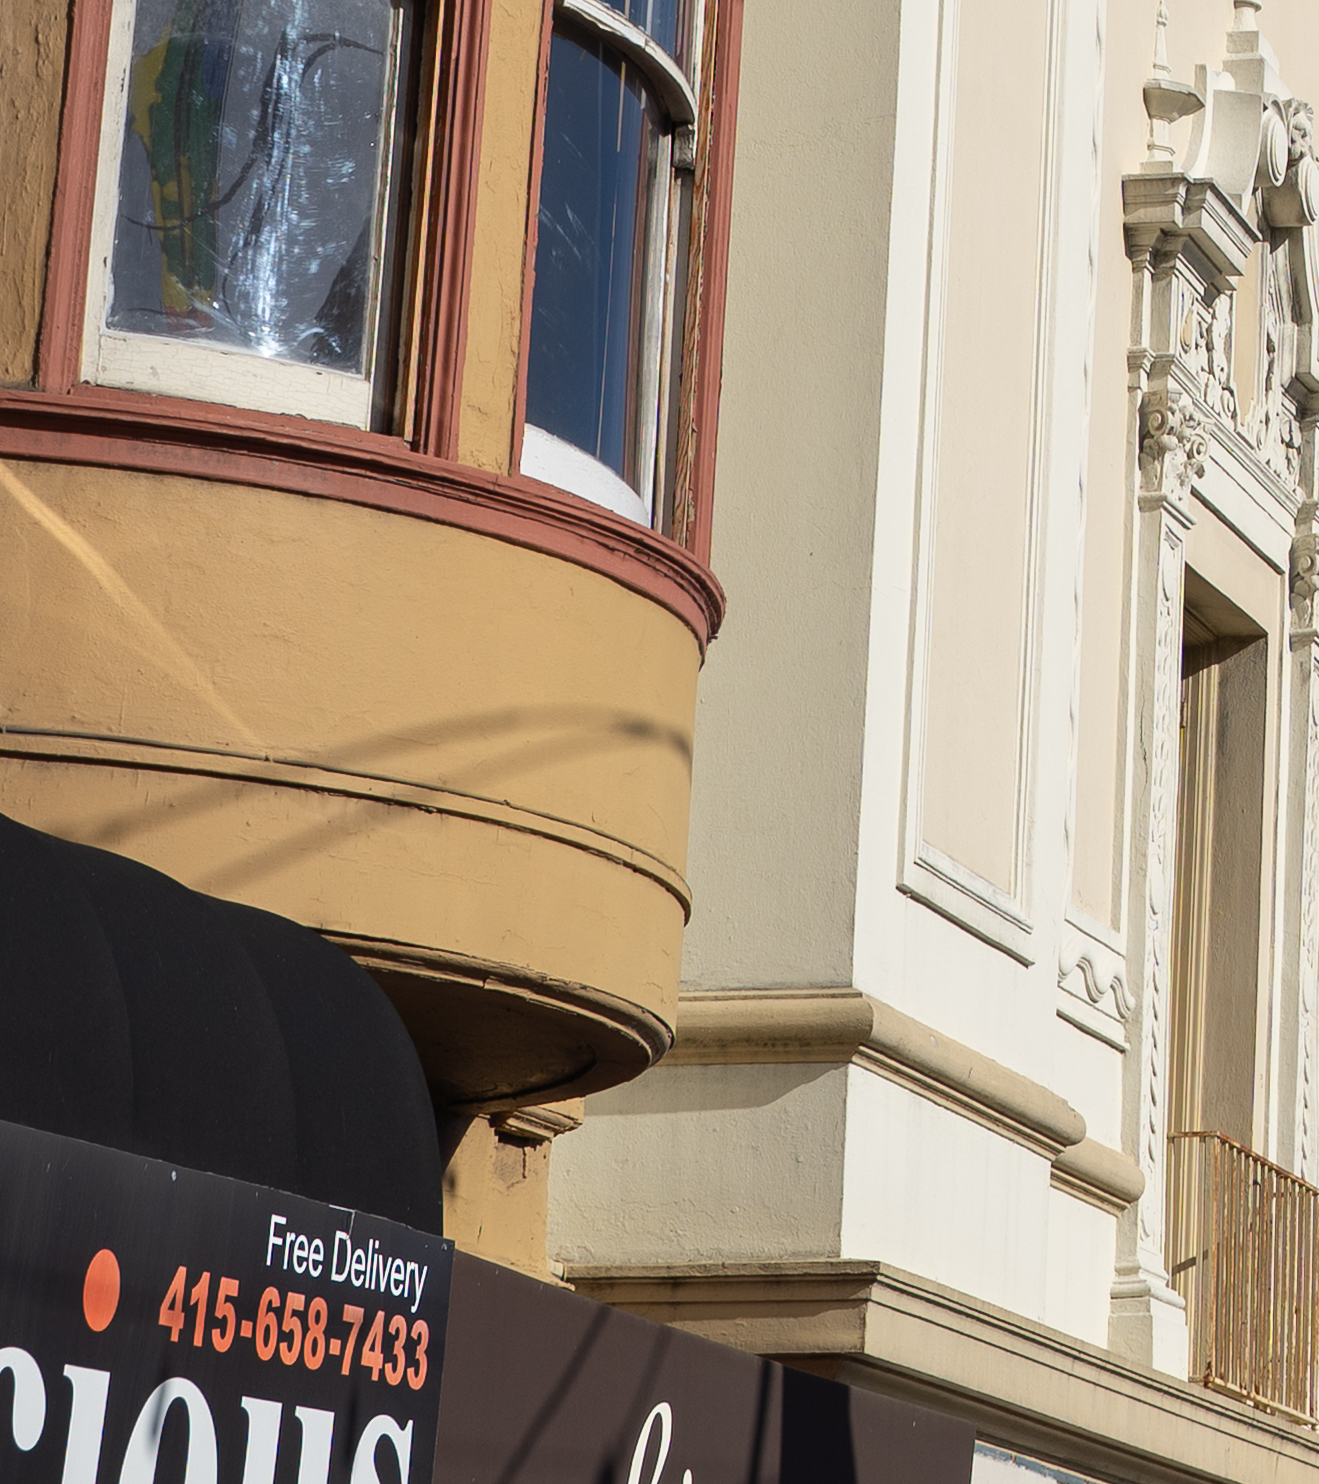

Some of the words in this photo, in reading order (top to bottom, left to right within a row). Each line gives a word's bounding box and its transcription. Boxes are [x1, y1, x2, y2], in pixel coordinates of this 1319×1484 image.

[266, 1214, 325, 1280] Free
[331, 1239, 428, 1314] Delivery
[157, 1265, 430, 1391] 415-658-7433
